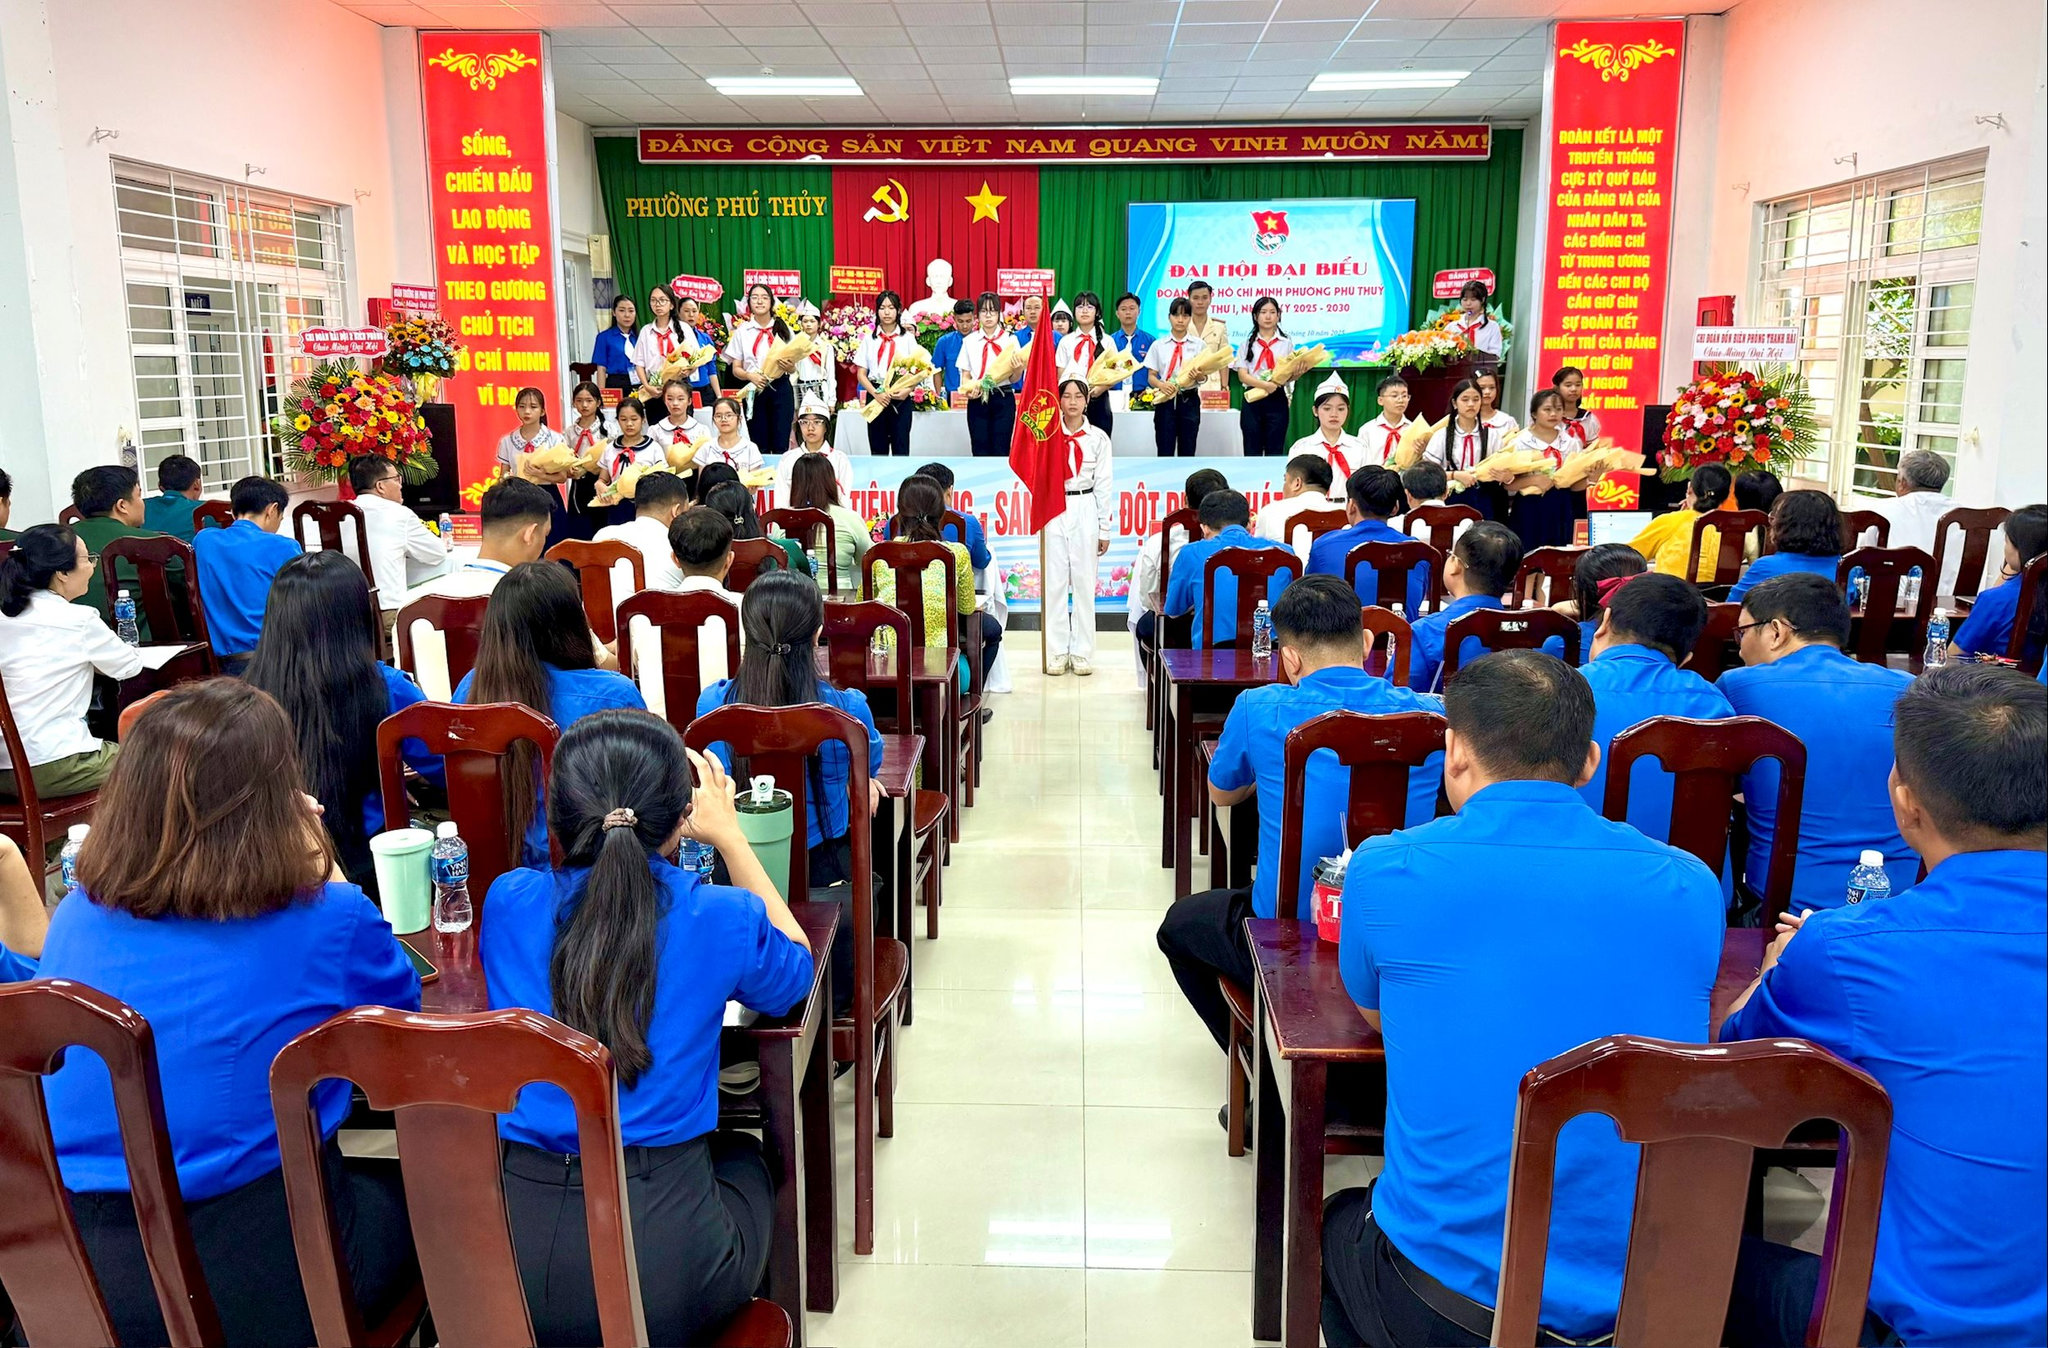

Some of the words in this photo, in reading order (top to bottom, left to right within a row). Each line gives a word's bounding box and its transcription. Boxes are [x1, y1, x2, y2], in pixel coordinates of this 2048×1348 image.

[462, 128, 512, 158] SỐNG,
[648, 133, 734, 153] ĐẢNG
[747, 135, 830, 156] CỘNG
[842, 133, 903, 153] SẢN
[917, 135, 992, 157] VIỆT
[1006, 139, 1076, 153] NAM
[1089, 138, 1197, 157] QUANG
[1209, 136, 1288, 152] VINH
[1301, 131, 1391, 150] MUÔN
[1406, 130, 1489, 149] NĂM!
[1559, 128, 1592, 144] ĐOÀN
[1595, 126, 1617, 144] KẾT
[1619, 128, 1634, 144] LÀ
[1637, 127, 1663, 146] MỘT
[1616, 147, 1655, 164] THỐNG
[446, 166, 494, 192] CHIẾN
[498, 165, 532, 192] ĐẤU
[1561, 171, 1585, 188] CỰC
[1632, 170, 1656, 185] BÁU
[627, 191, 709, 217] PHƯỜNG
[716, 190, 759, 217] PHÚ
[768, 189, 827, 217] THỦY
[1557, 190, 1580, 207] CỦA
[1583, 189, 1616, 206] ĐẢNG
[1619, 190, 1634, 206] VÀ
[1637, 189, 1661, 206] CỦA
[452, 209, 482, 229] LAO
[486, 205, 531, 233] ĐỘNG
[1567, 211, 1601, 228] NHÂN
[1603, 211, 1628, 227] DÂN
[1631, 213, 1647, 228] TA.
[1563, 232, 1587, 248] CÁC
[1624, 232, 1646, 248] CHÍ
[446, 241, 469, 265] VÀ
[473, 245, 506, 269] HỌC
[509, 241, 540, 269] TẬP
[1560, 252, 1576, 268] TỪ
[1577, 254, 1615, 268] TRUNG
[1618, 253, 1650, 268] ƯƠNG
[1169, 264, 1208, 281] ĐẠI
[1218, 260, 1257, 281] HỘI
[1265, 263, 1306, 281] ĐẠI
[1316, 256, 1368, 276] BIỂU
[445, 281, 486, 300] THEO
[491, 279, 546, 301] GƯƠNG
[1558, 272, 1582, 289] ĐẾN
[1584, 273, 1608, 289] CÁC
[1610, 275, 1631, 289] CHI
[1633, 273, 1650, 291] BỘ
[1293, 304, 1317, 313] 2025
[1326, 303, 1350, 312] 2030
[1594, 294, 1616, 309] GIỮ
[1617, 293, 1638, 309] GÌN
[461, 310, 493, 336] CHỦ
[497, 316, 534, 339] TỊCH
[1562, 315, 1580, 332] SỰ
[1580, 313, 1614, 330] ĐOÀN
[1616, 312, 1639, 330] KẾT
[1543, 332, 1576, 349] NHẤT
[1577, 334, 1597, 349] TRÍ
[1598, 332, 1622, 349] CỦA
[1624, 332, 1657, 349] ĐẢNG
[475, 348, 502, 371] CHÍ
[506, 352, 550, 371] MINH
[1589, 354, 1611, 370] GIỮ
[1612, 354, 1633, 370] GÌN
[477, 383, 494, 405] VĨ
[1120, 482, 1160, 546] ĐỘT
